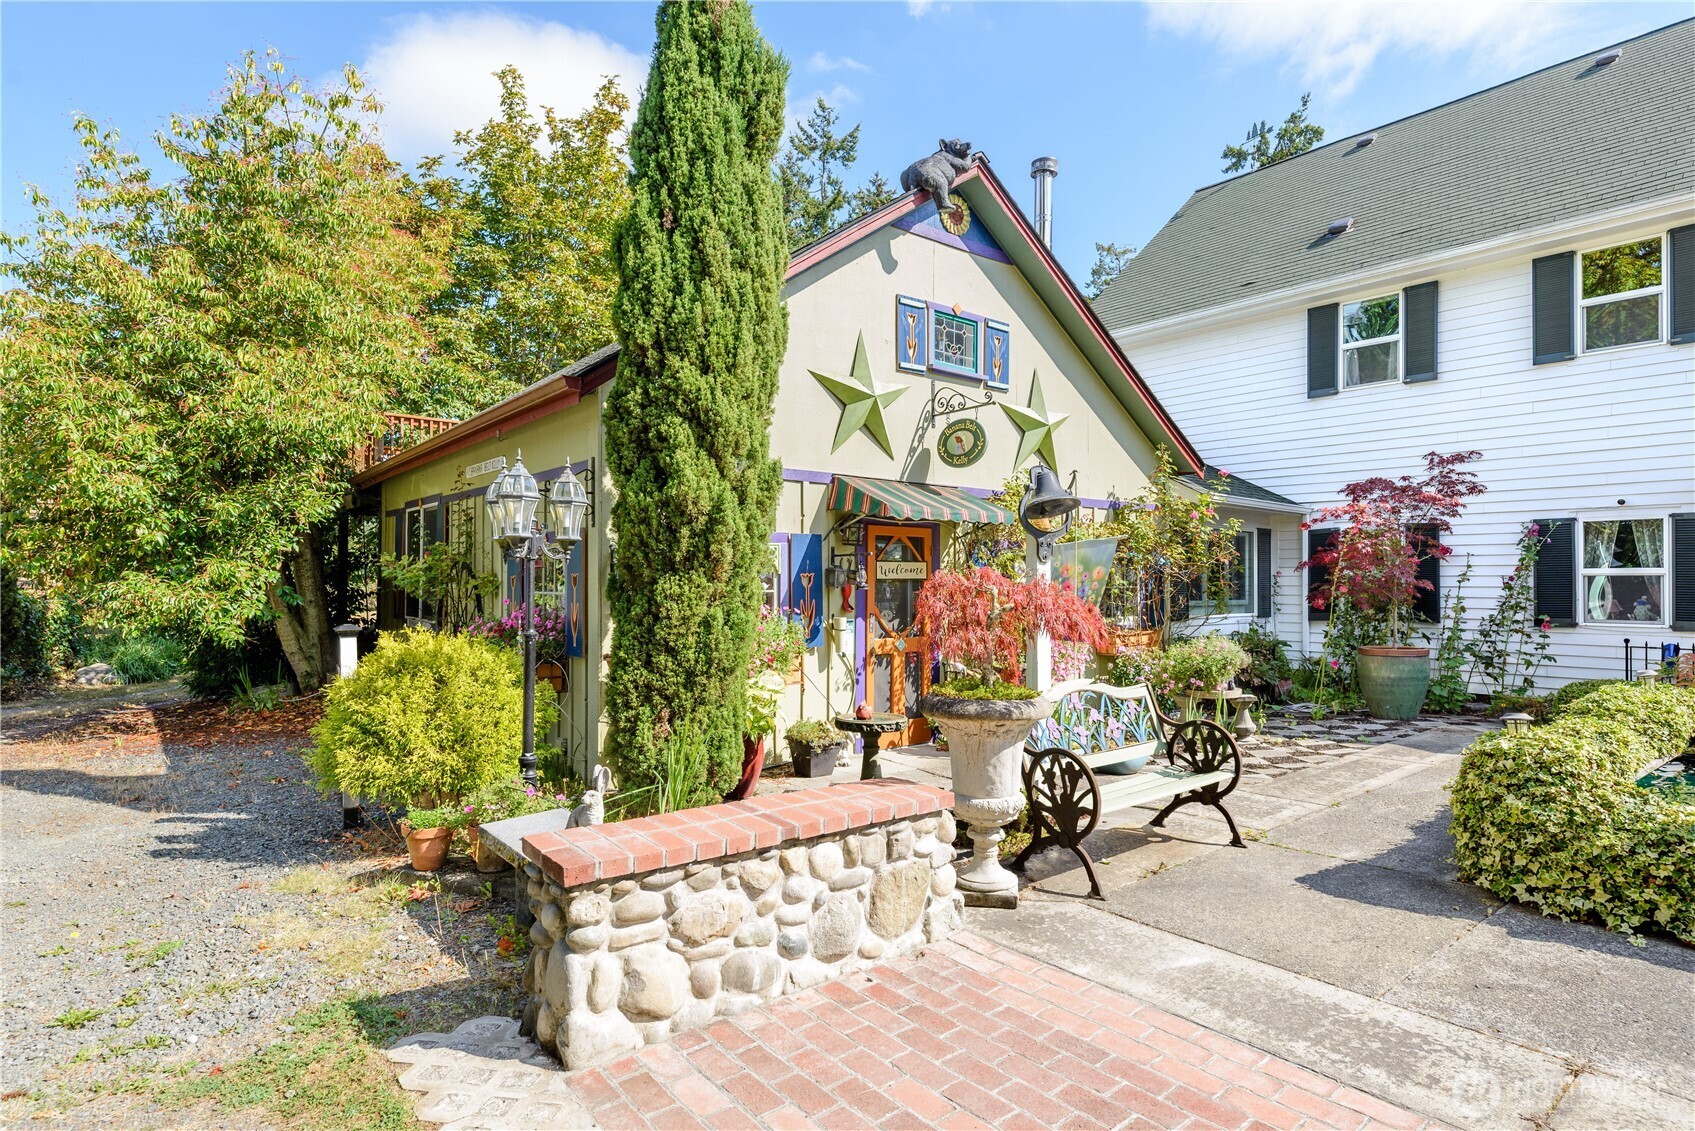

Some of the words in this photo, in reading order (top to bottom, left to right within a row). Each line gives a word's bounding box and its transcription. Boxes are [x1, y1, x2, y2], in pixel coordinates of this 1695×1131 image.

[944, 423, 965, 436] Banana
[965, 420, 977, 431] Belt
[953, 455, 968, 465] Kelly
[879, 563, 924, 577] Welcome
